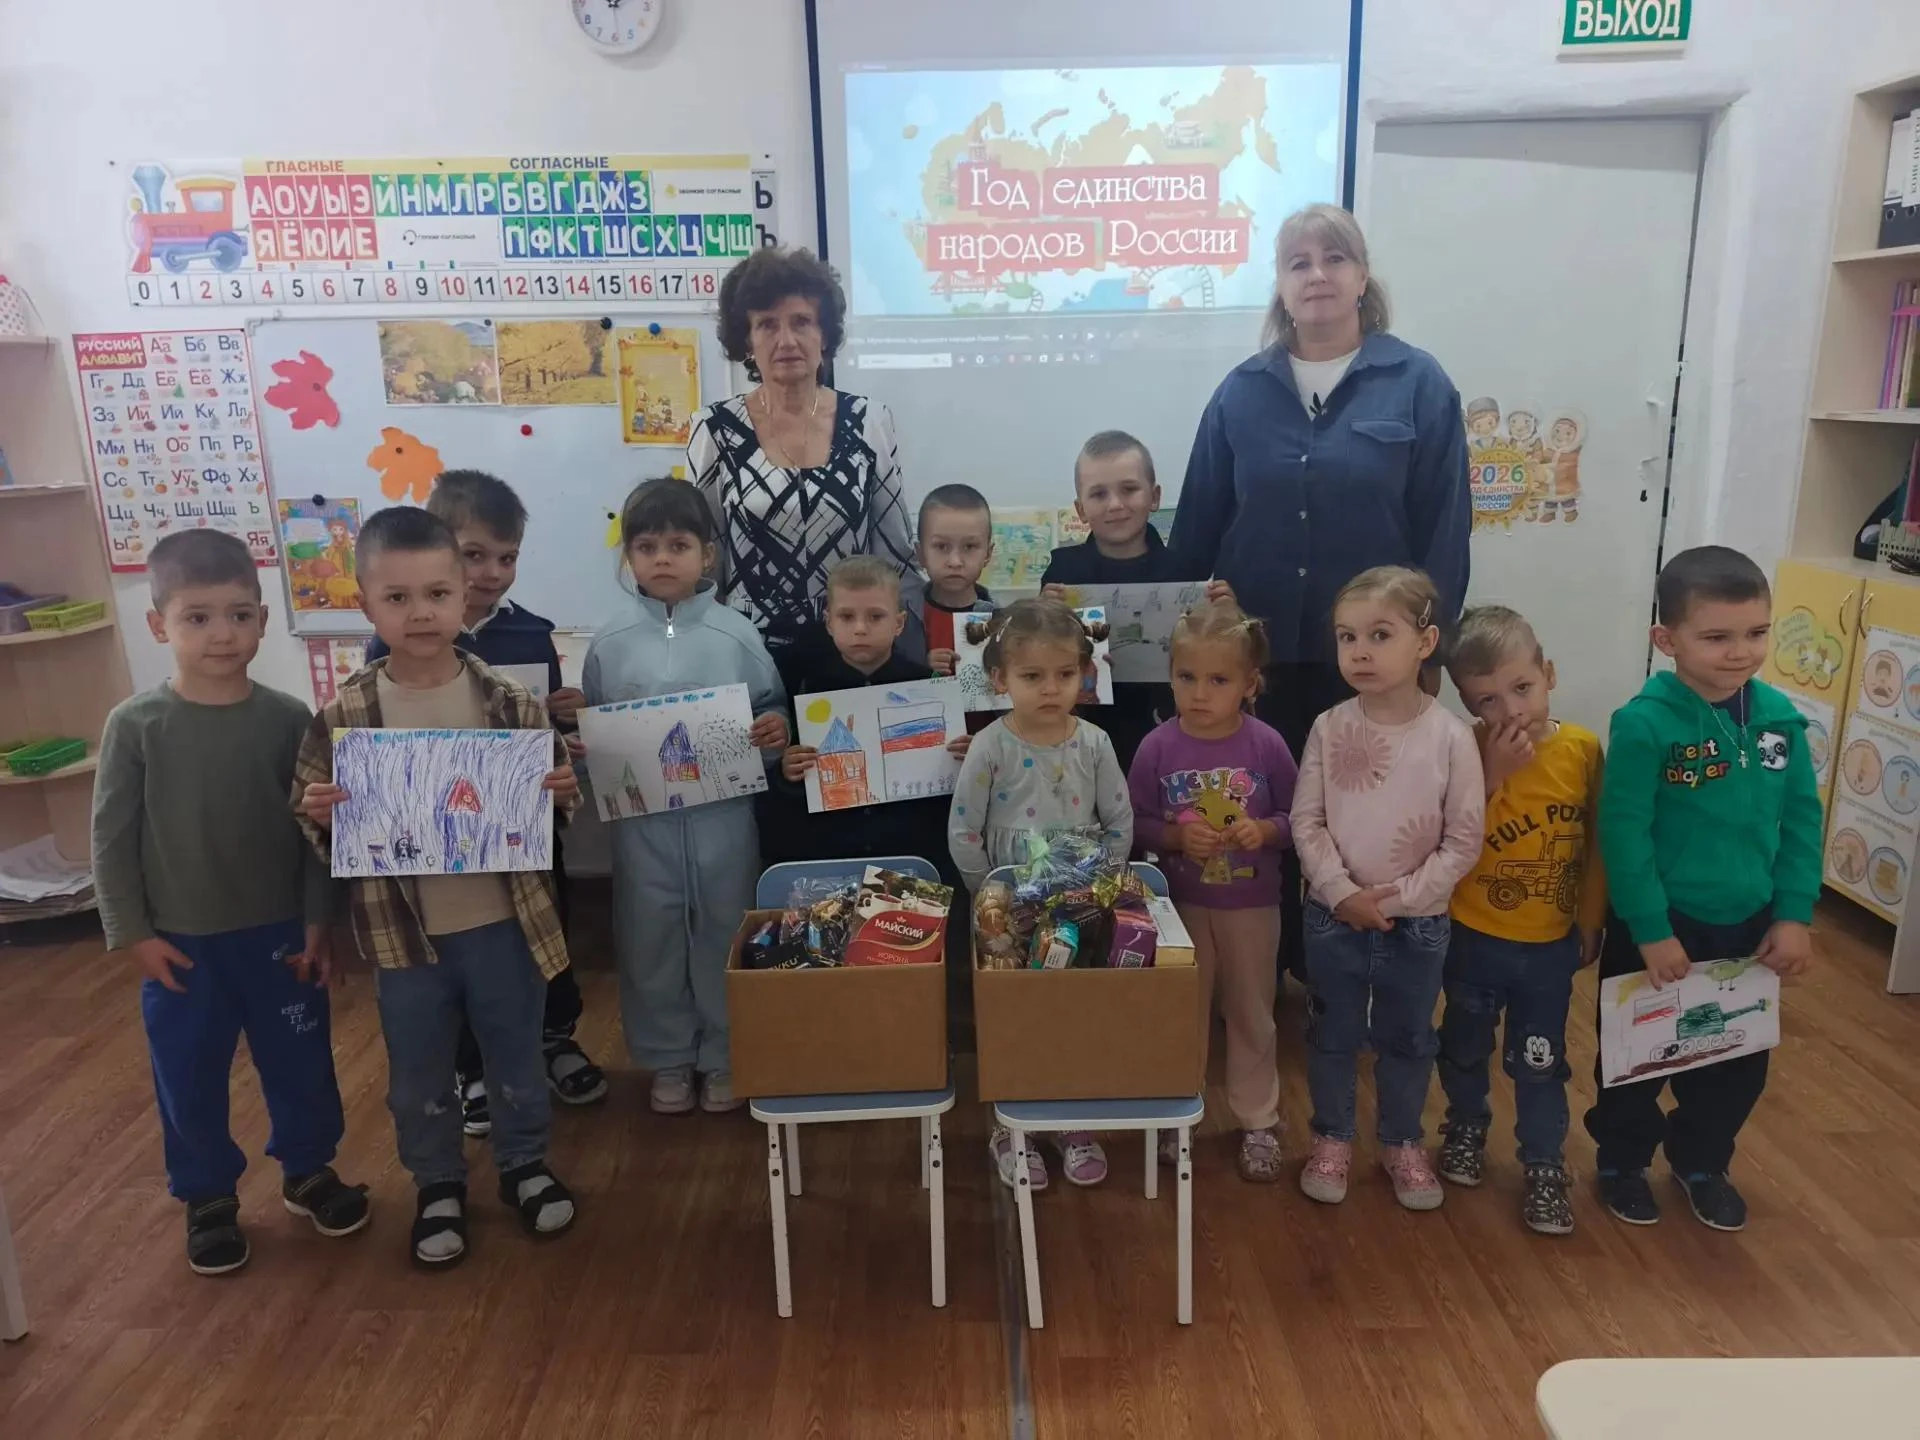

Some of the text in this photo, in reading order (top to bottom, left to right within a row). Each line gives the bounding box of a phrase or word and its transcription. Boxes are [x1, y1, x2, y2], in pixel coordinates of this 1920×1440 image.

[1573, 0, 1680, 37] ВЫХОД
[266, 160, 343, 173] ГЛАСНЫЕ
[509, 156, 609, 169] СОГЛАСНЫЕ
[970, 167, 1208, 211] Год единства
[938, 219, 1238, 273] народов России
[138, 274, 716, 301] 0 1 2 3 4 5 6 7 8 9 10 11 12 13 14 15 16 17 18
[77, 337, 142, 352] РУССКИЙ
[79, 351, 144, 366] АЛФАВИТ
[1470, 464, 1525, 484] 2026
[1486, 813, 1540, 853] FULL
[875, 918, 924, 939] МАЙСКИЙ
[281, 1003, 305, 1015] KEEP
[290, 1014, 303, 1025] IT
